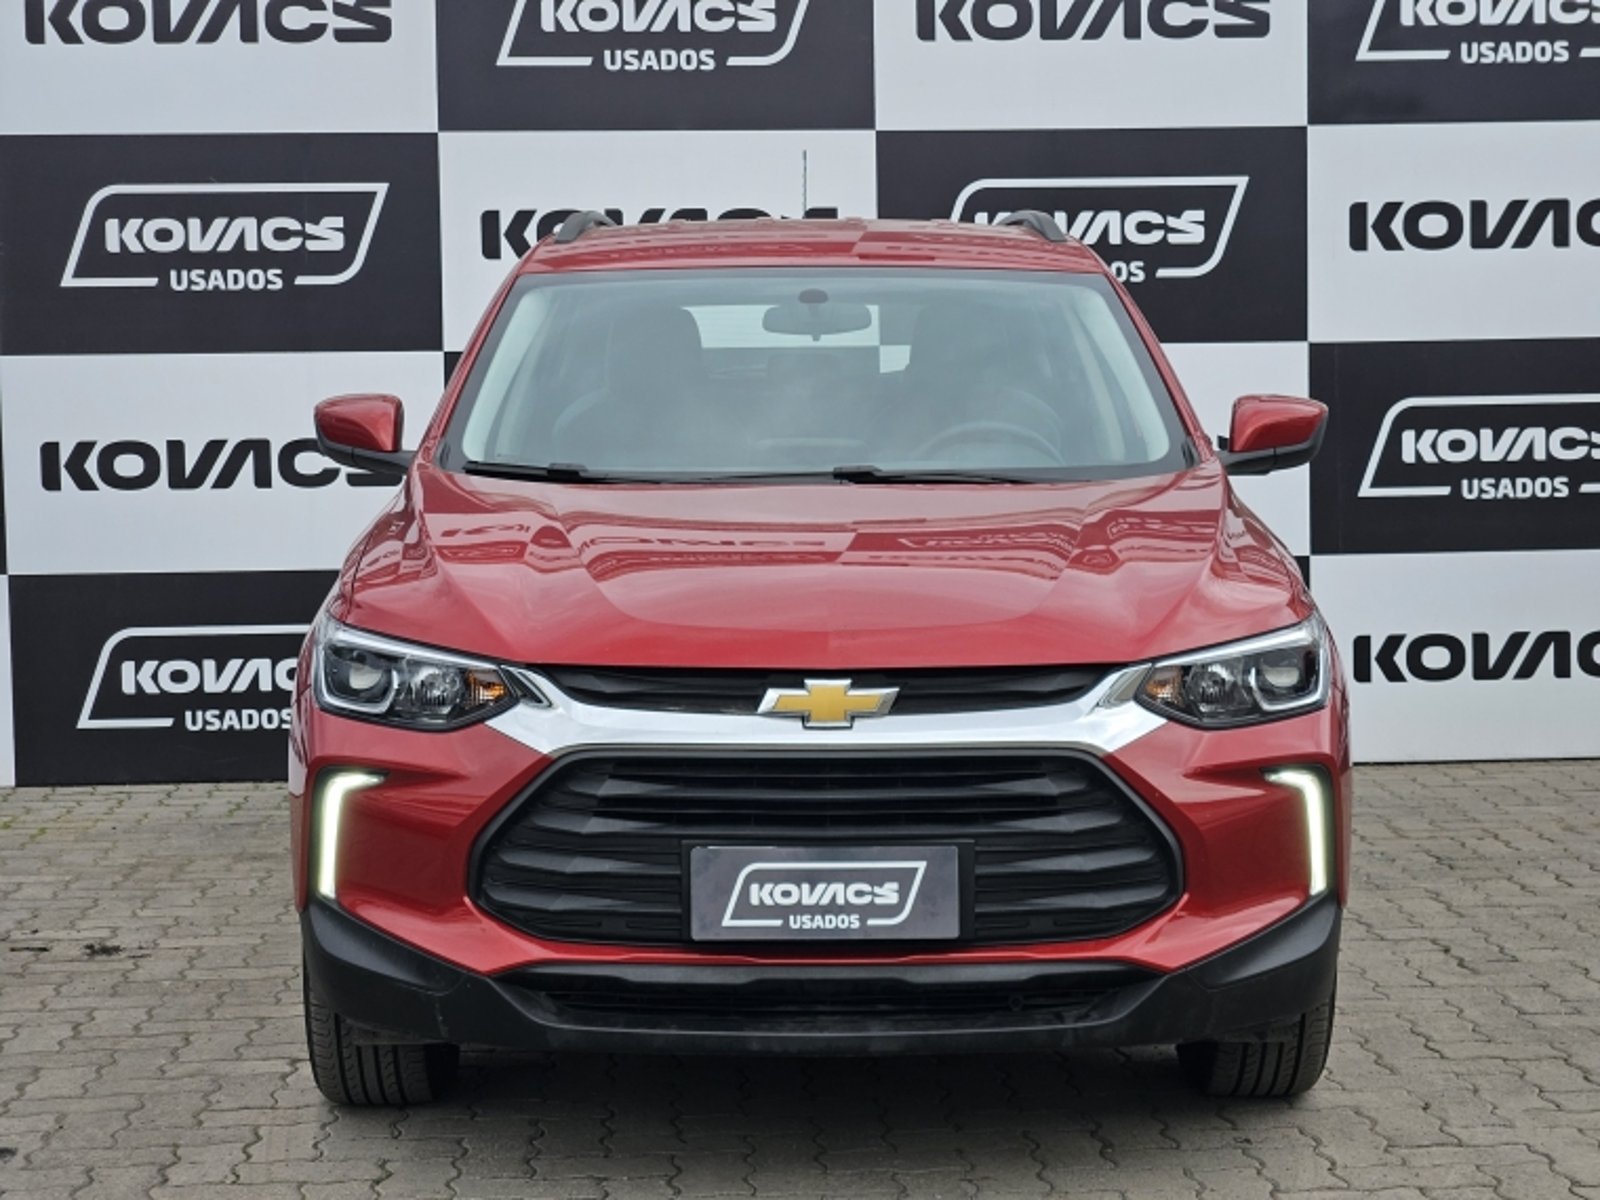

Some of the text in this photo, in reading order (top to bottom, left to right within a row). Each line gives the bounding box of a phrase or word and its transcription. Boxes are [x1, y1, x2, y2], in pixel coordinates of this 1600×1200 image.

[25, 0, 392, 44] KOVACS
[540, 0, 777, 32] KOVACS
[916, 0, 1270, 41] KOVACS
[1400, 0, 1600, 26] KOVAC
[603, 49, 716, 71] USADOS
[1460, 40, 1570, 64] USADOS
[105, 216, 345, 253] KOVACS
[169, 268, 283, 291] USADOS
[1401, 426, 1600, 463] KOVAC
[1461, 476, 1569, 499] USADOS
[749, 881, 900, 906] KOVACS
[789, 914, 860, 929] USADOS
